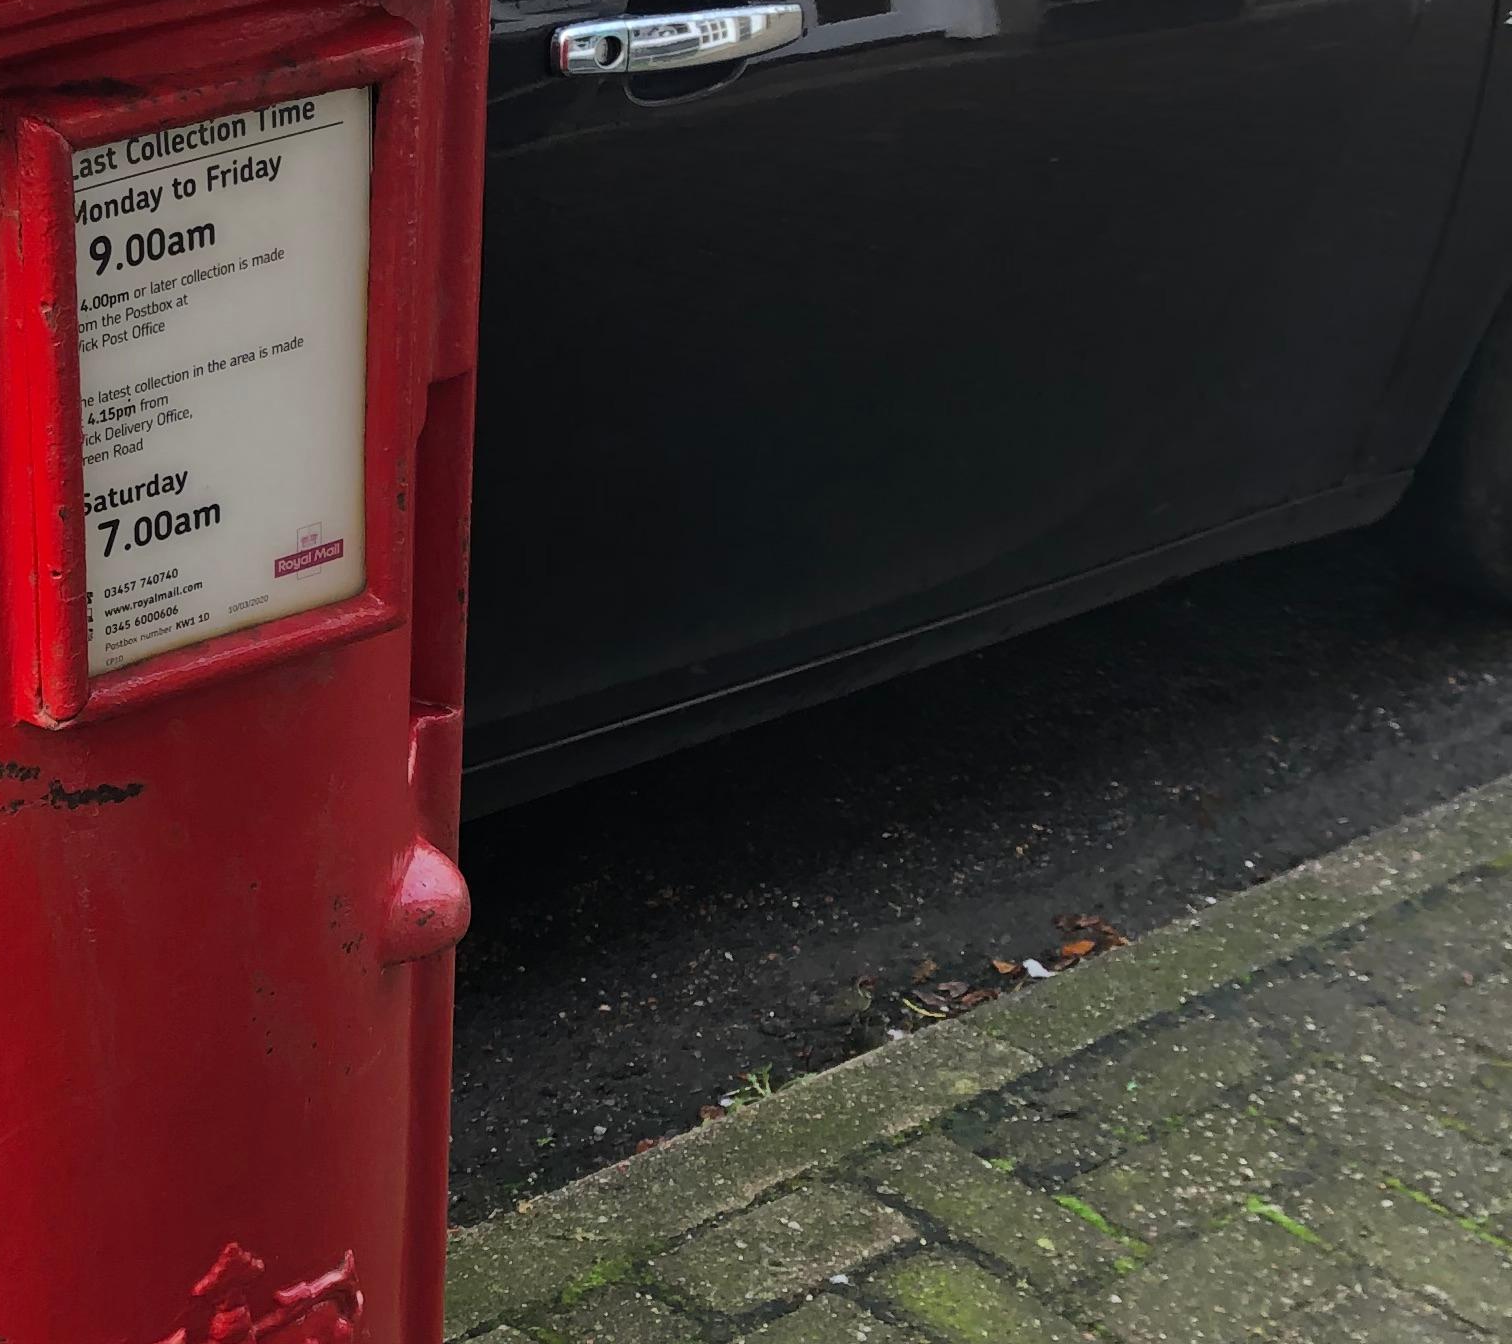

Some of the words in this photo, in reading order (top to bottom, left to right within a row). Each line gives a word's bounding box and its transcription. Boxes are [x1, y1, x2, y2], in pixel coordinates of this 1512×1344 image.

[126, 117, 246, 164] Collection
[257, 101, 315, 131] Time
[172, 178, 196, 199] to
[207, 155, 282, 192] Friday
[89, 222, 215, 276] 9.00am
[80, 290, 130, 312] 4.00pm
[133, 285, 147, 299] or
[150, 277, 178, 295] later
[180, 260, 235, 286] collection
[238, 256, 249, 270] is
[251, 247, 285, 267] made
[102, 312, 122, 328] the
[125, 299, 173, 322] Postbox
[176, 293, 189, 307] at
[102, 329, 129, 348] Post
[132, 320, 166, 340] Office
[98, 384, 131, 405] latest
[134, 369, 190, 394] collection
[193, 364, 204, 378] in
[207, 357, 227, 373] the
[229, 351, 256, 367] area
[259, 345, 269, 359] is
[271, 336, 304, 355] made
[82, 431, 102, 447] ick
[105, 416, 154, 442] Delivery
[157, 407, 193, 427] Office,
[87, 403, 136, 426] 4.15pm
[140, 394, 169, 412] from
[82, 450, 109, 467] reen
[113, 437, 144, 458] Road
[97, 503, 221, 558] 7.00am
[277, 551, 312, 574] Royal
[313, 542, 341, 562] Mail
[104, 580, 137, 599] 03457
[140, 568, 179, 589] 740740
[104, 580, 204, 617] www.royalmail.com
[105, 618, 131, 636] 0345
[134, 605, 179, 627] 6000606
[105, 637, 138, 652] Postbox
[140, 625, 172, 641] number
